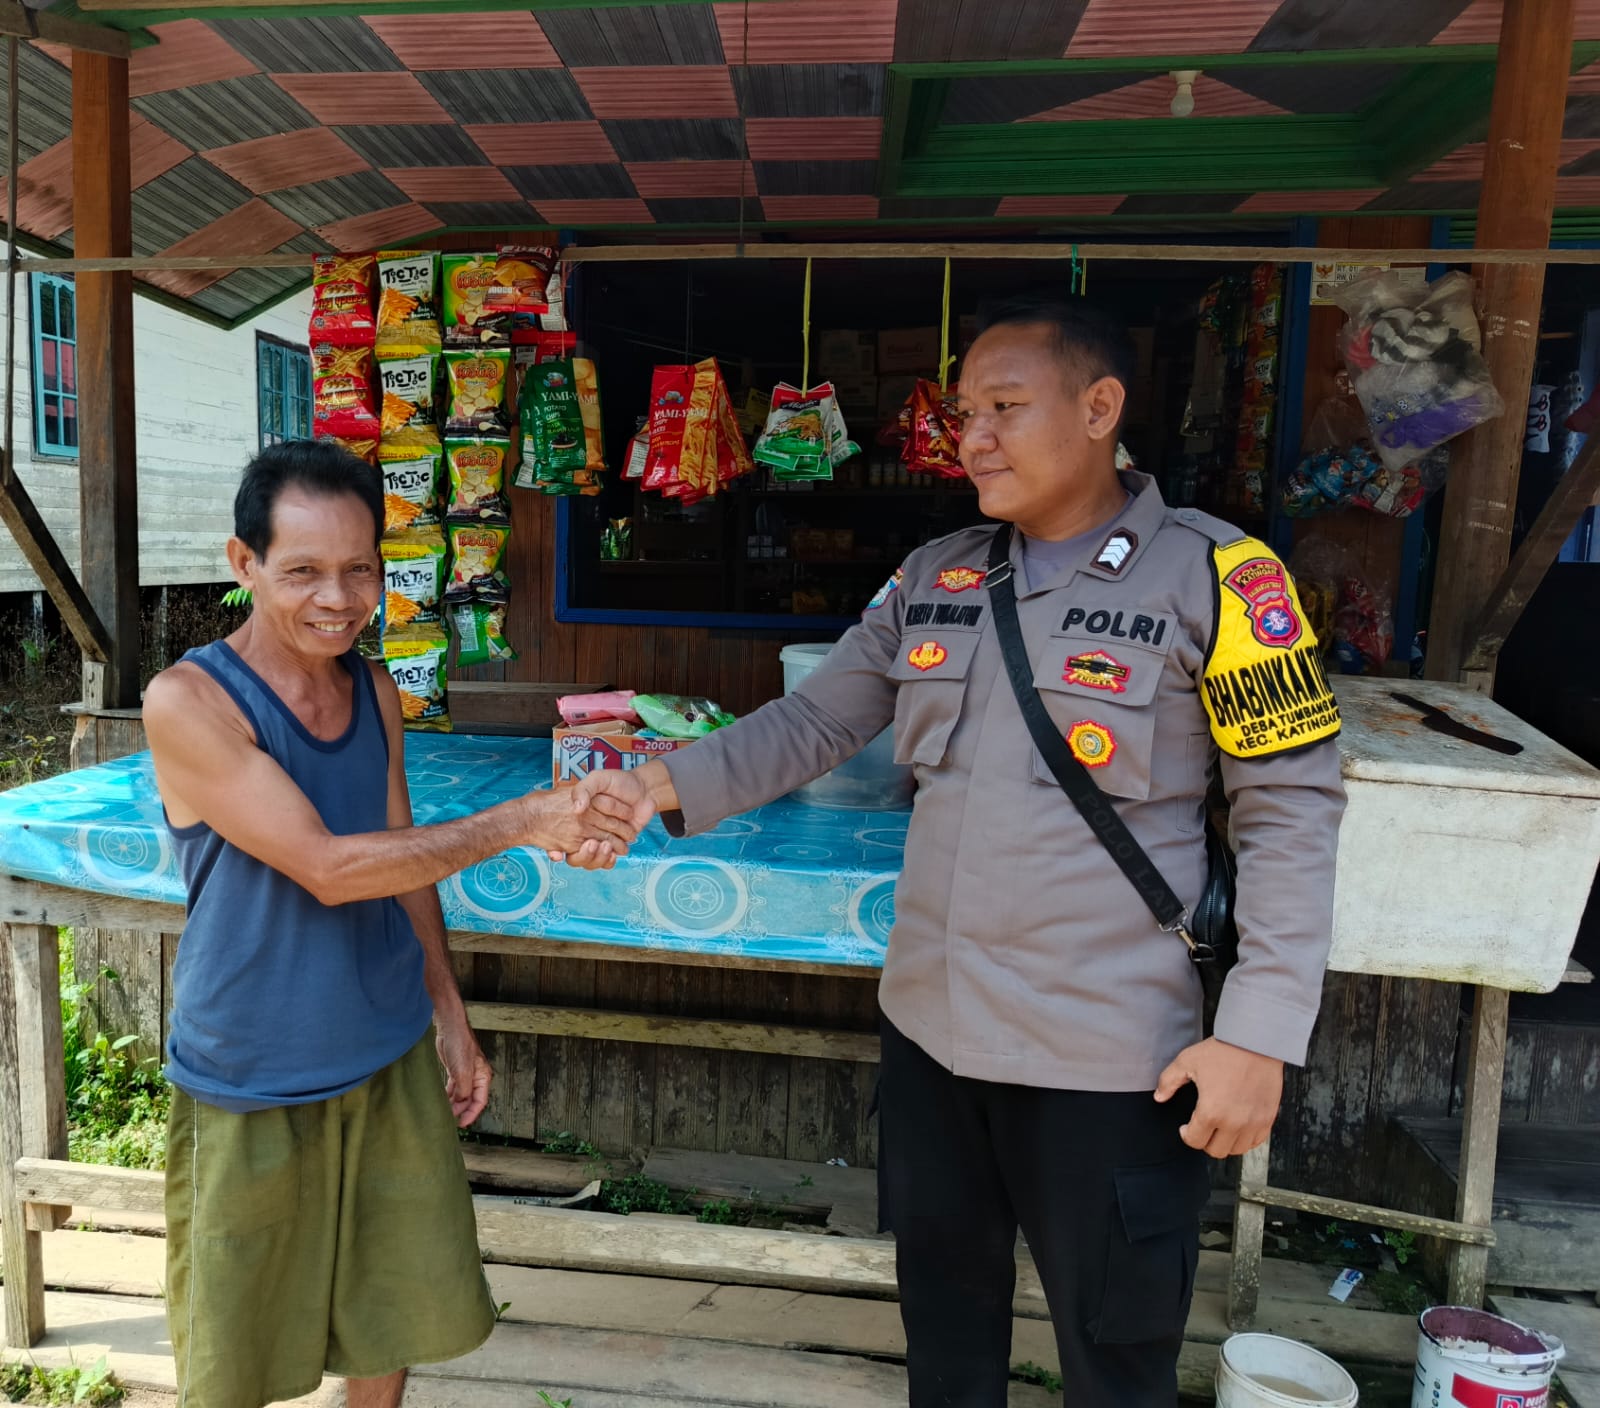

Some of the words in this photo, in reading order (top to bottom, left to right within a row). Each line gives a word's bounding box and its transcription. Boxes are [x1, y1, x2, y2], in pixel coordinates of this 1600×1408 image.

[1061, 606, 1168, 646] POLRI
[1240, 718, 1278, 737] DESA
[561, 736, 593, 751] OKKY
[645, 740, 673, 751] 2000
[1235, 734, 1272, 751] KEC.
